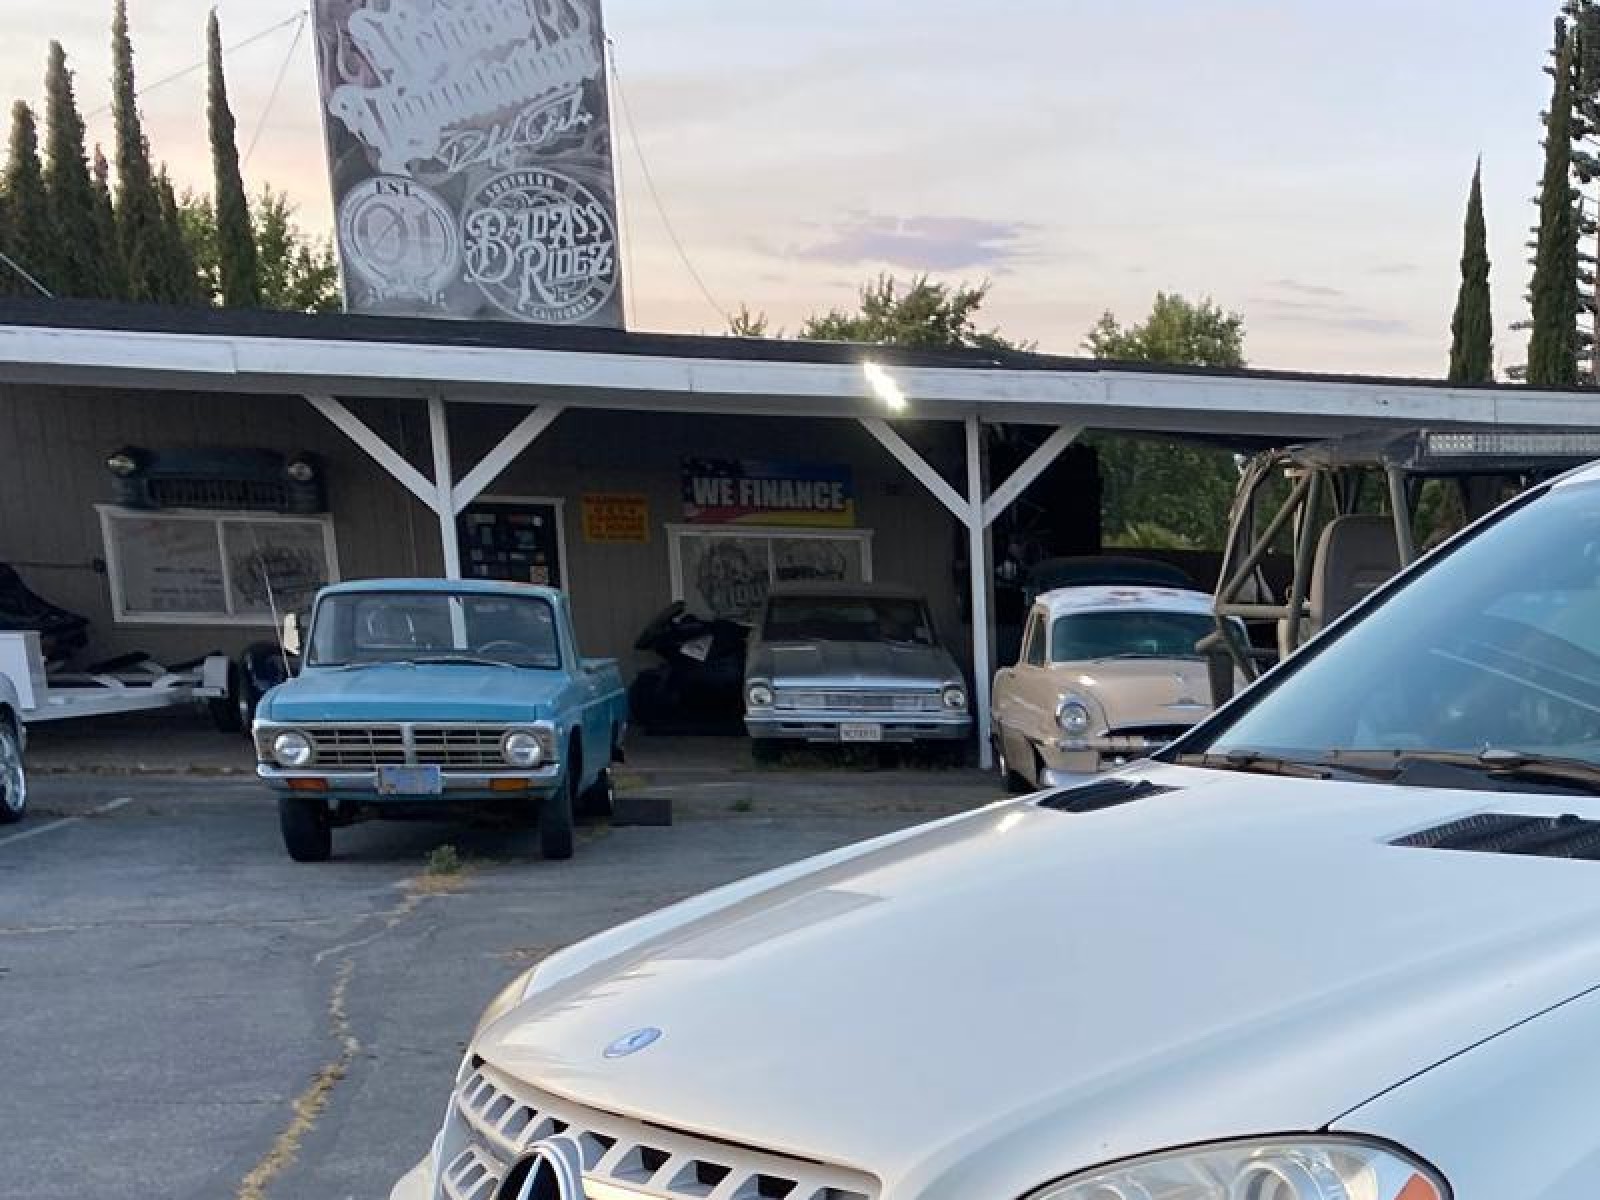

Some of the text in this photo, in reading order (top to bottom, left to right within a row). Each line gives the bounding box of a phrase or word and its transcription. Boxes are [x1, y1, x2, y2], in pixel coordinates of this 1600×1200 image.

[464, 203, 604, 283] BADASS
[514, 240, 613, 311] RIDEZ
[693, 477, 845, 508] WE FINANCE
